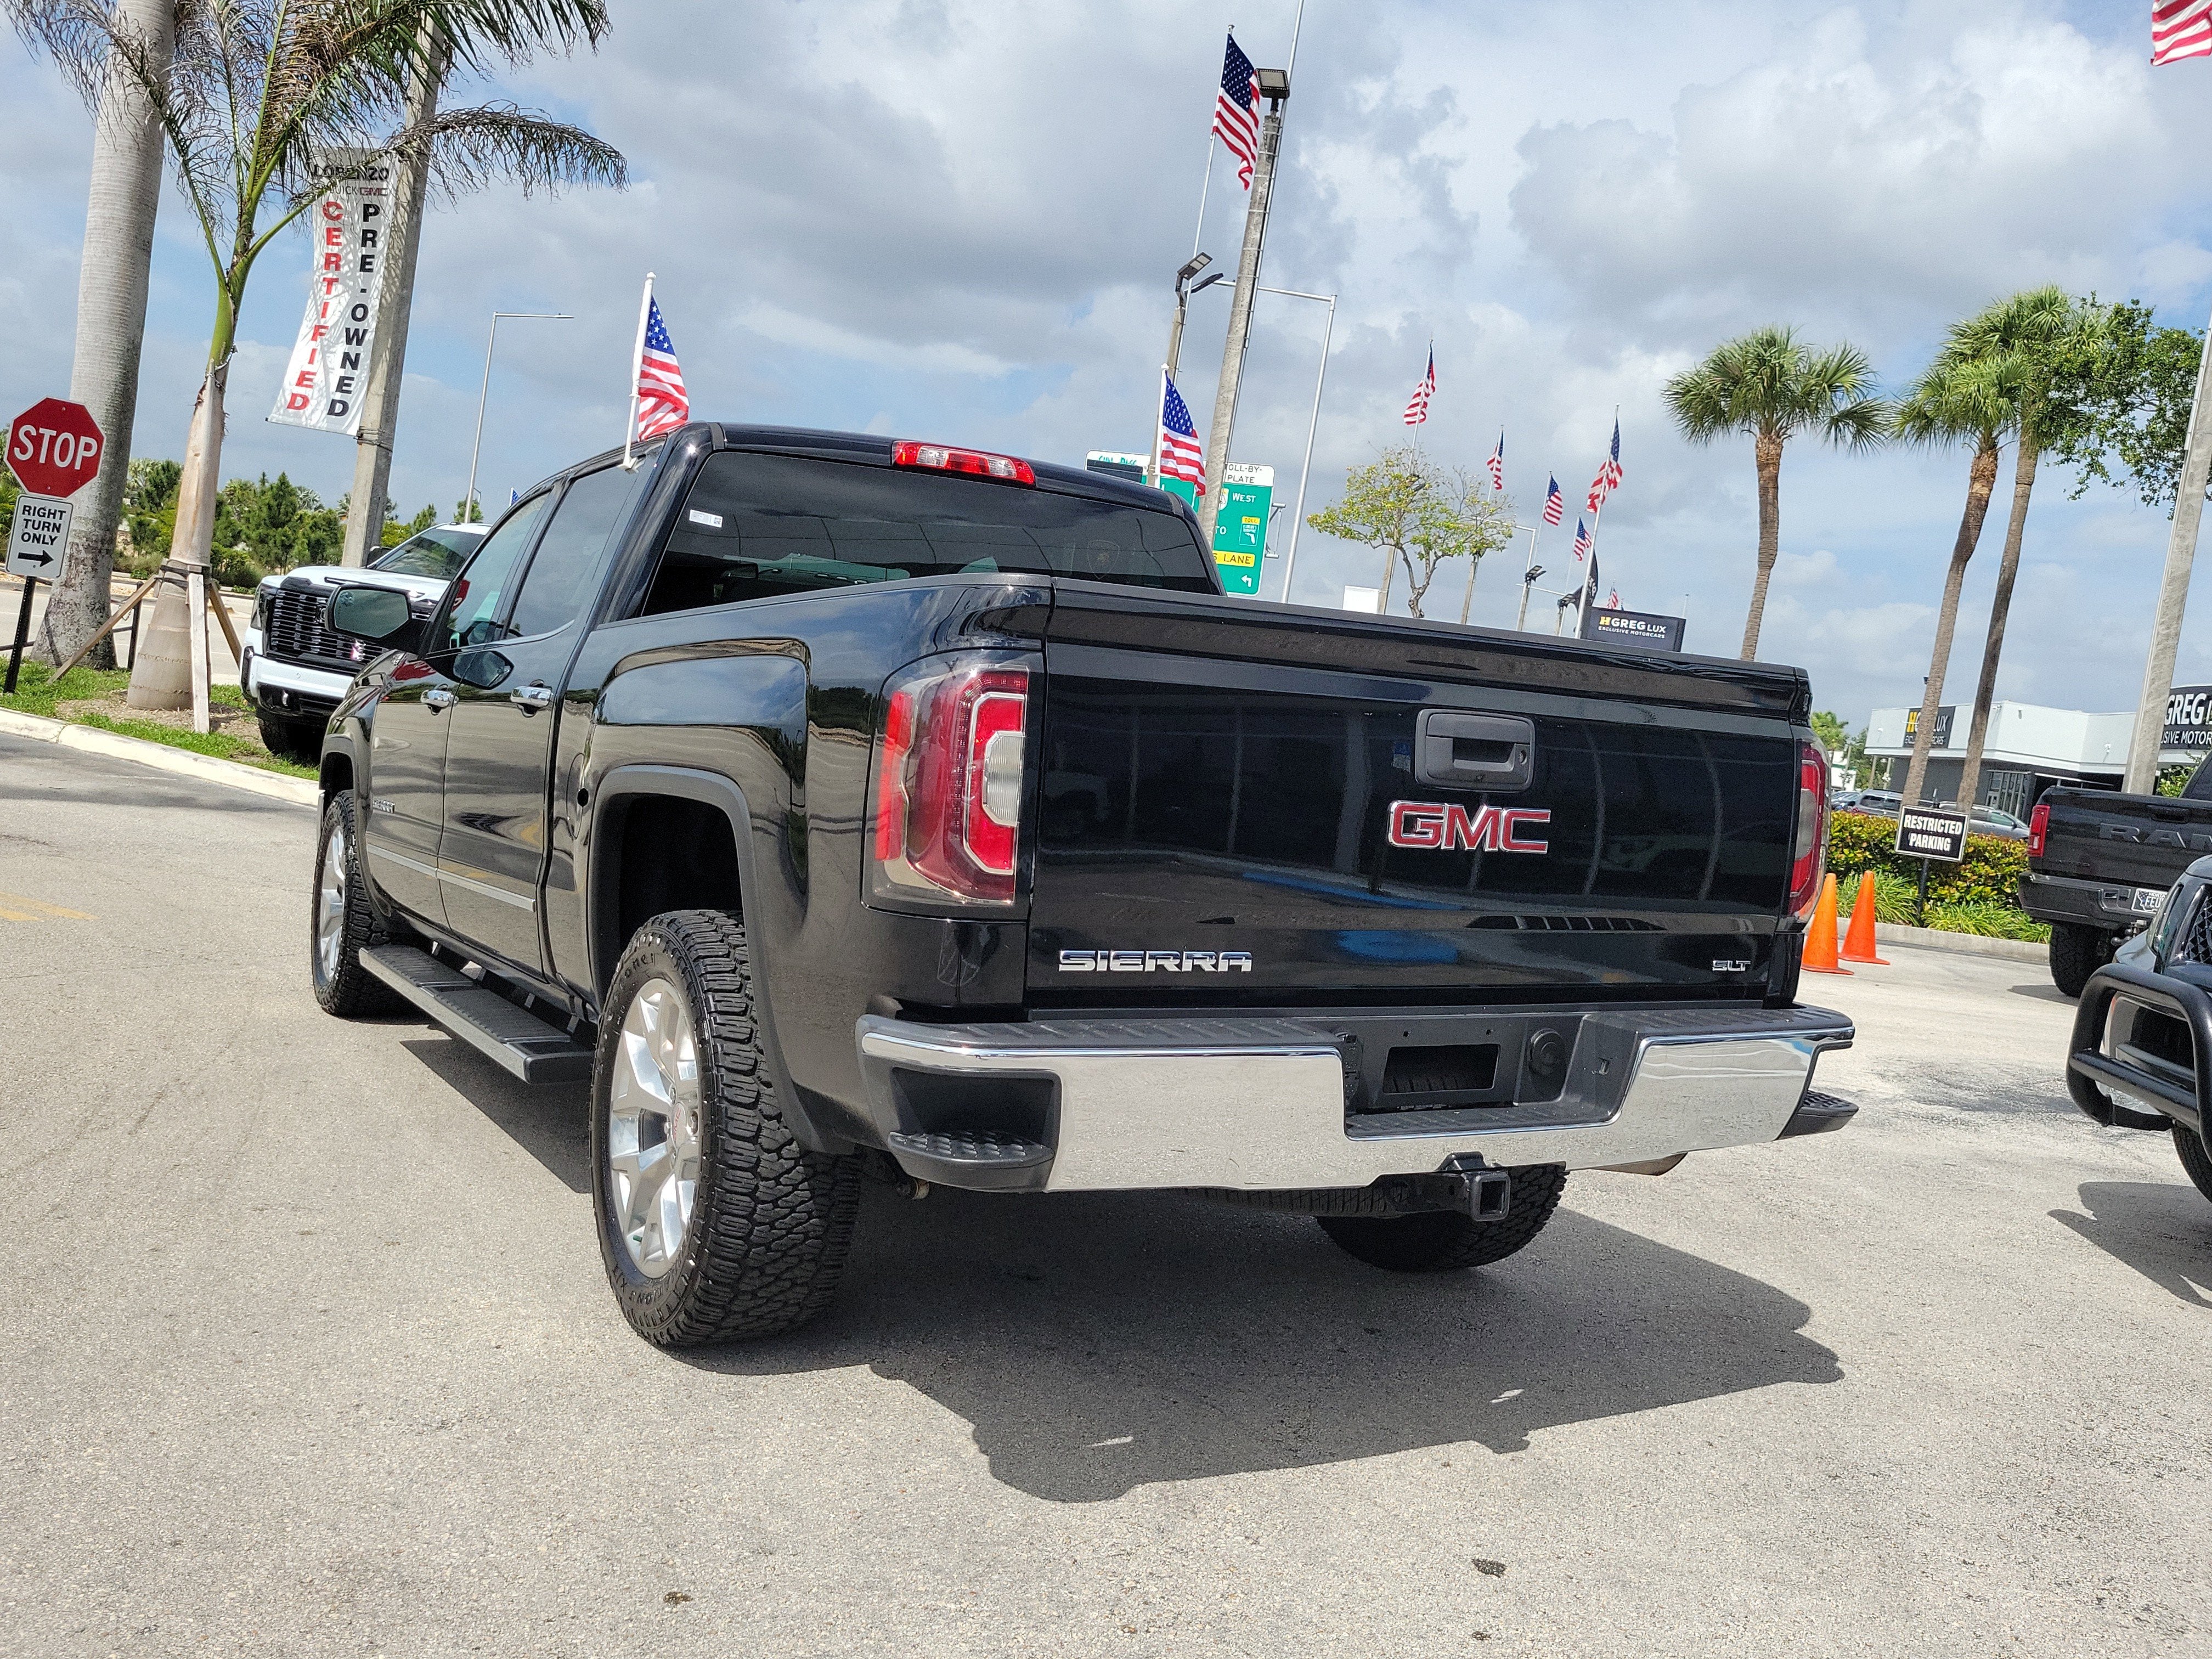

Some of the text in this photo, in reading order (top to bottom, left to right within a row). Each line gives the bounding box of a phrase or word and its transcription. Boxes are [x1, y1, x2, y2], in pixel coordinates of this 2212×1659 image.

[331, 185, 388, 196] UICK GMC
[286, 201, 344, 411] CERTIFIED
[326, 203, 381, 417] PRE-OWNED
[14, 424, 98, 470] STOP
[1228, 464, 1262, 473] OLL-BY-
[1227, 475, 1255, 483] PLATE
[1232, 492, 1256, 503] WEST
[22, 504, 66, 521] RIGHT
[23, 518, 61, 534] TURN
[21, 532, 58, 546] ONLY
[1223, 554, 1251, 564] LANE
[1598, 625, 1665, 639] EXCLUSIVE MOTORCARS
[1647, 624, 1667, 633] LUX
[1387, 800, 1551, 854] GMC
[1904, 814, 1963, 835] RESTRICTED
[1909, 833, 1952, 851] PARKING
[1059, 950, 1252, 972] SIERRA
[1712, 960, 1751, 972] SLT
